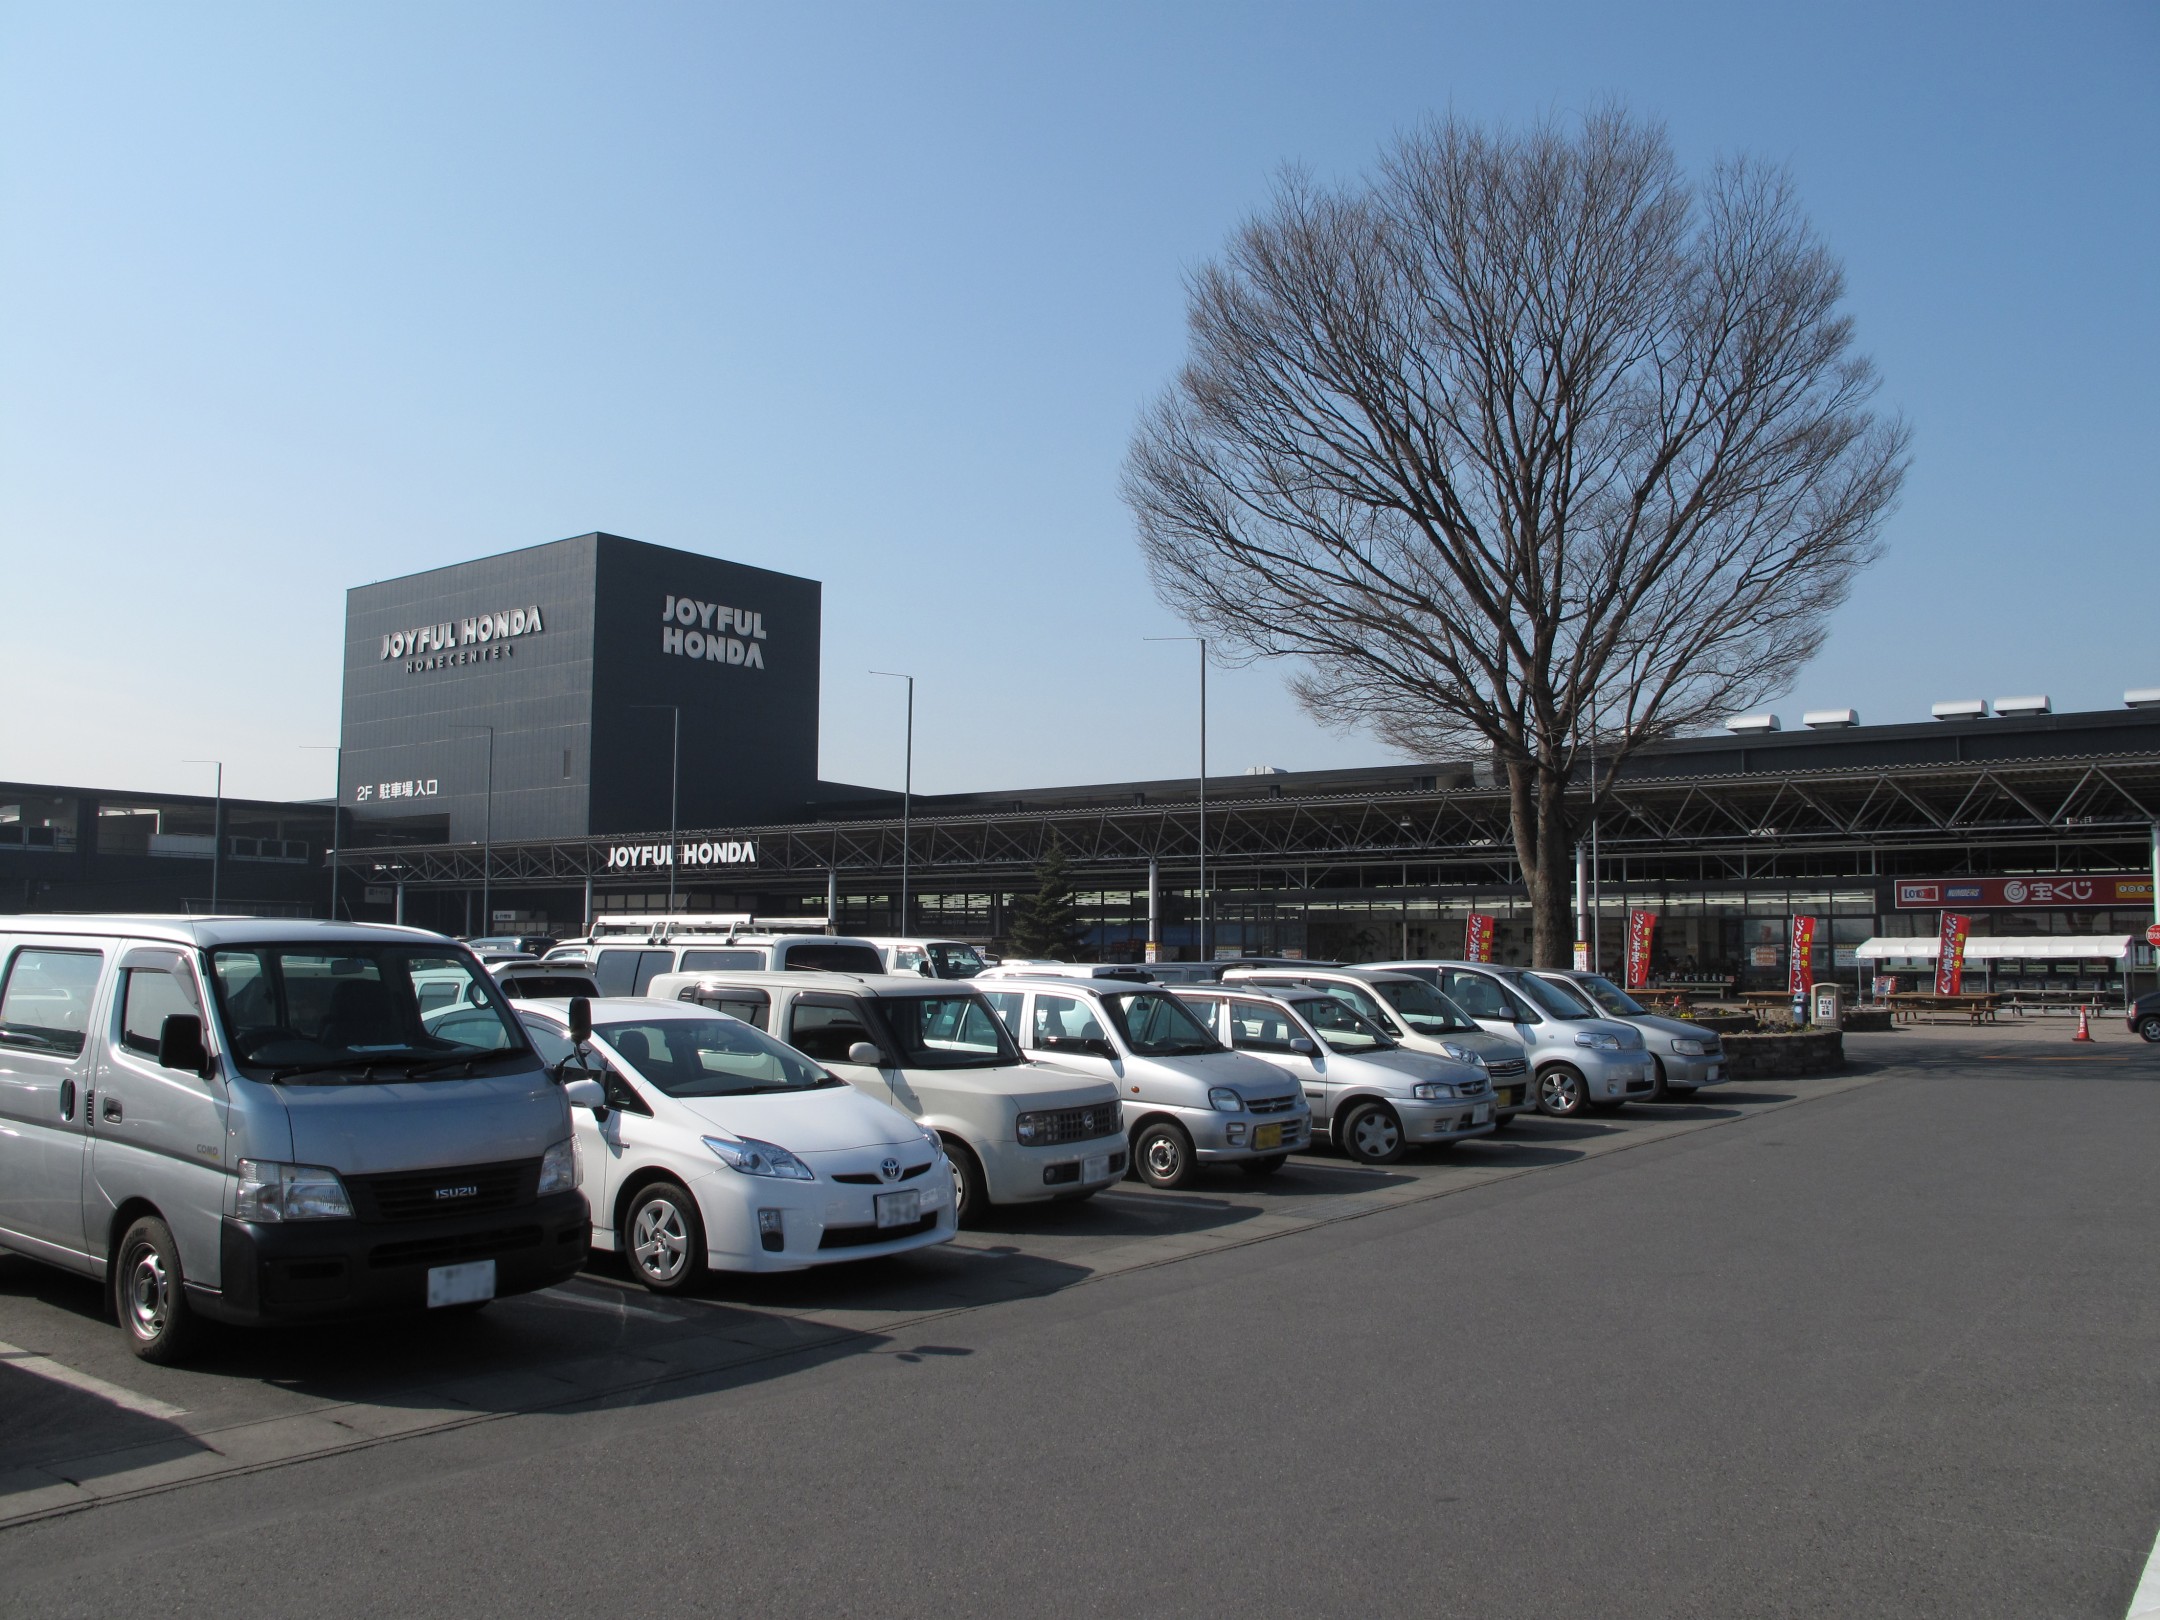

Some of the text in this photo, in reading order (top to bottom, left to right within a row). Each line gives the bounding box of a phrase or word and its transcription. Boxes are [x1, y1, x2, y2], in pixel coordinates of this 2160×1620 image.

[663, 595, 767, 640] JOYFUL
[381, 605, 543, 660] JOYFUL HONDA
[405, 644, 512, 674] HOMECENTER
[663, 626, 765, 670] HONDA
[356, 779, 438, 801] 2F 駐車場入口
[608, 841, 756, 868] JOYFUL HONDA
[2030, 881, 2093, 901] 宝くじ
[435, 1186, 478, 1199] ISUZU
